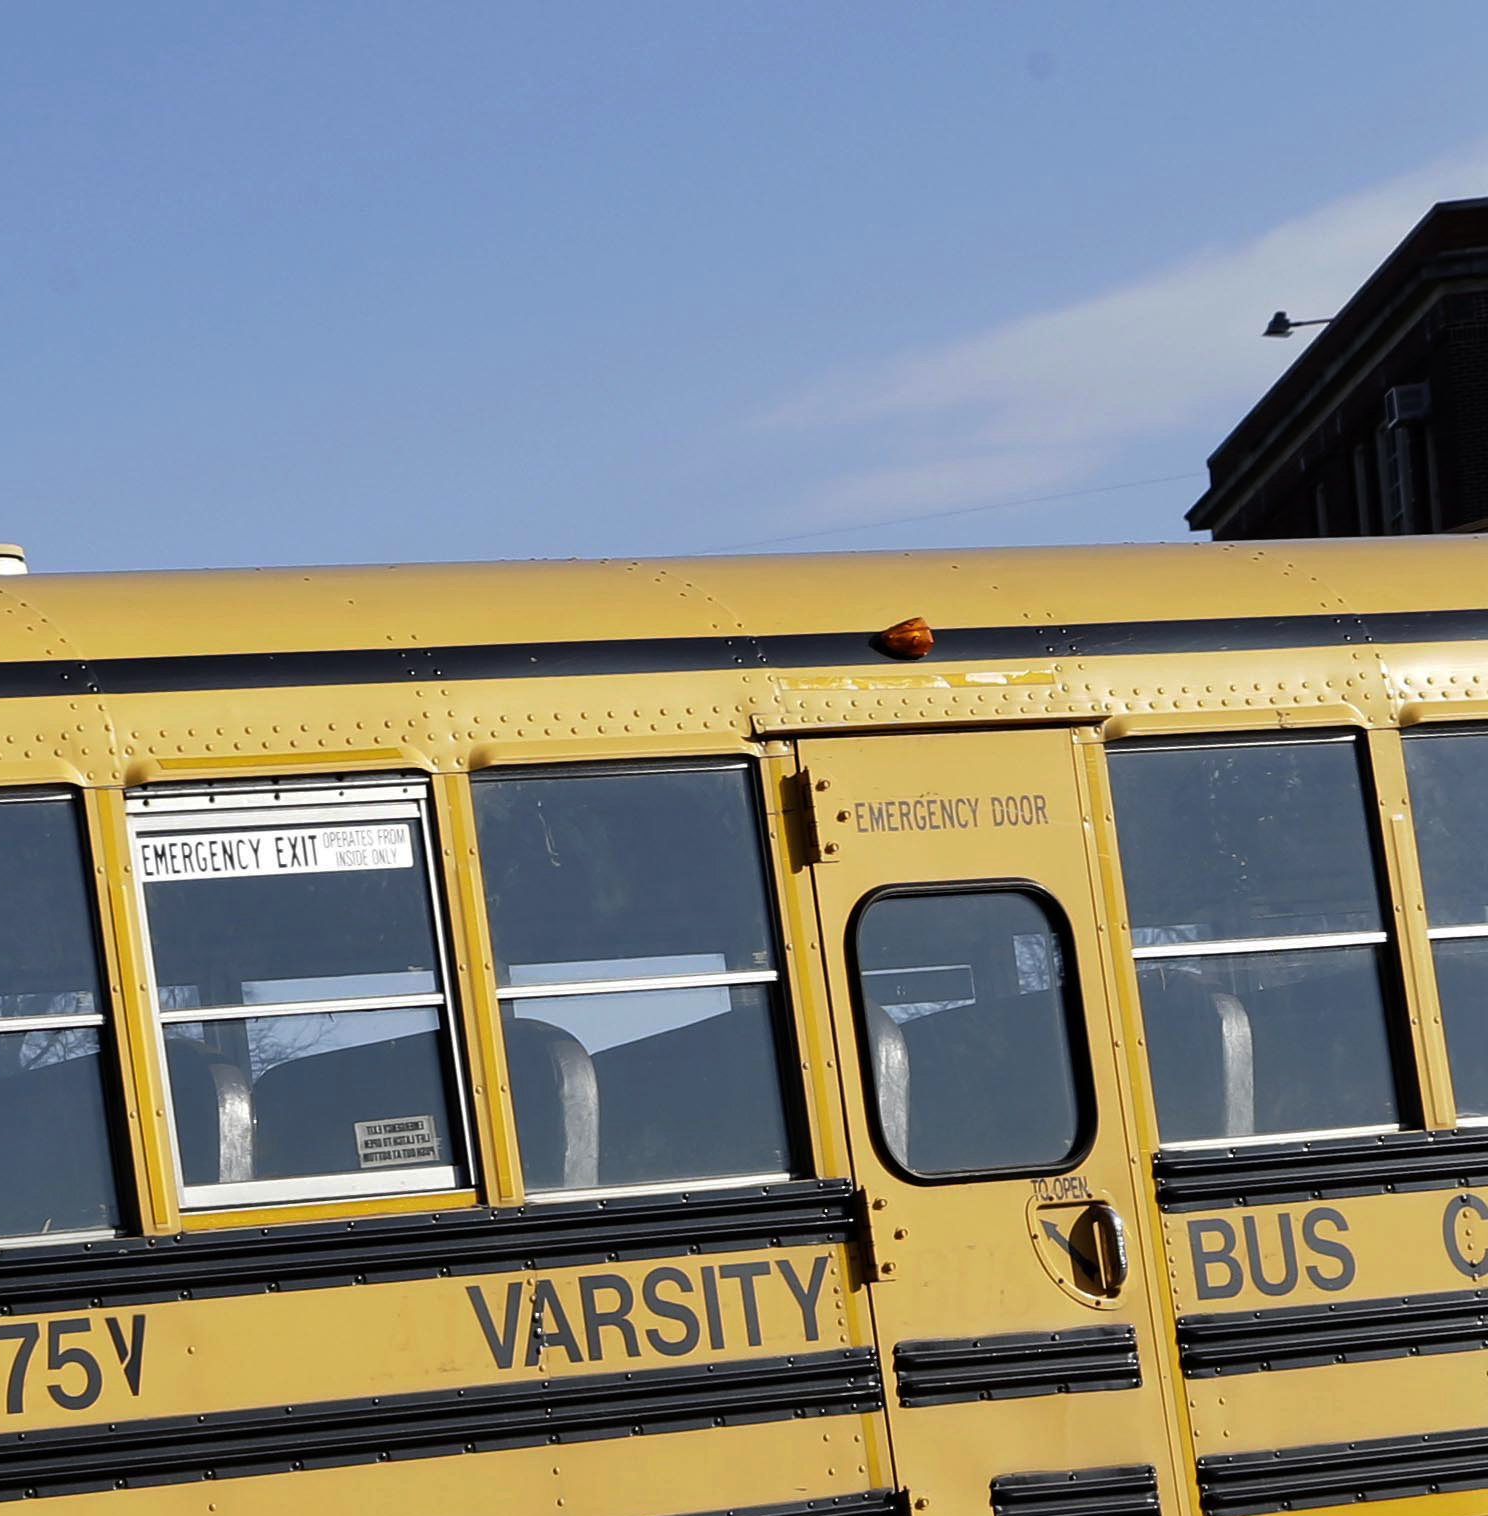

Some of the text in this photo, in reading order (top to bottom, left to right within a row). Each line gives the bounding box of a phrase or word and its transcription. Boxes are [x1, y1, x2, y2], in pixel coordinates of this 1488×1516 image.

[854, 794, 1049, 833] EMERGENCY DOOR
[140, 834, 320, 876] EMERGENCY EXIT
[322, 828, 407, 849] OPERATES FROM
[335, 848, 398, 867] INSIDE ONLY
[1030, 1175, 1089, 1202] TO OPEN
[465, 1255, 829, 1370] VARSITY
[1187, 1206, 1356, 1300] BUS
